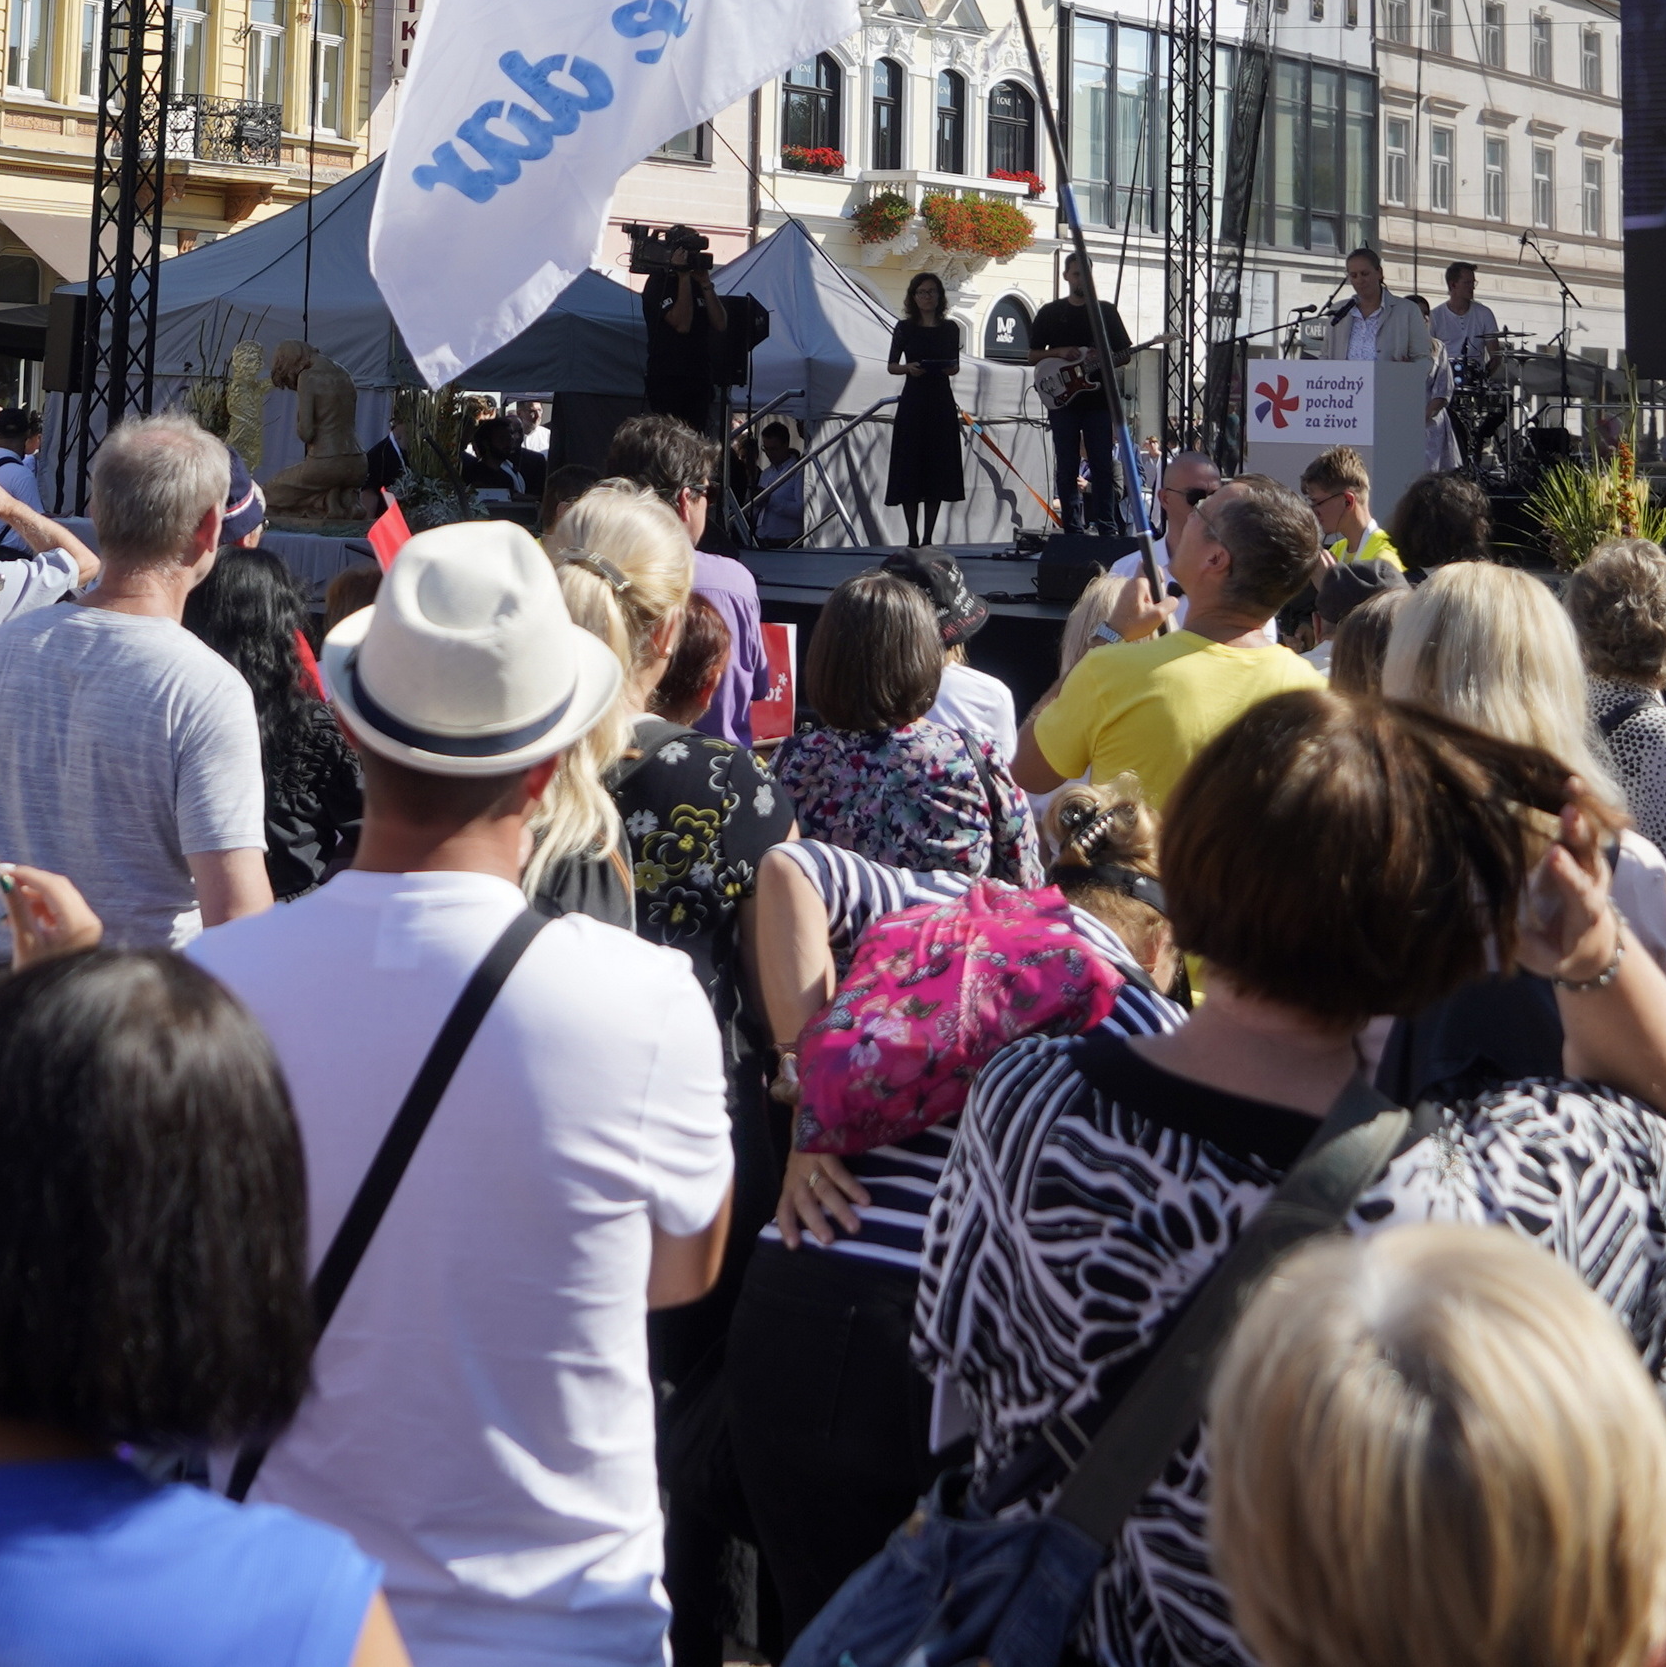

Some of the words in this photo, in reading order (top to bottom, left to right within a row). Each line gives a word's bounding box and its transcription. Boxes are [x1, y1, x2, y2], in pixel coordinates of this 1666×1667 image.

[1305, 375, 1364, 394] národný
[1305, 394, 1354, 412] pochod
[1305, 418, 1320, 428] za
[1323, 414, 1358, 429] život
